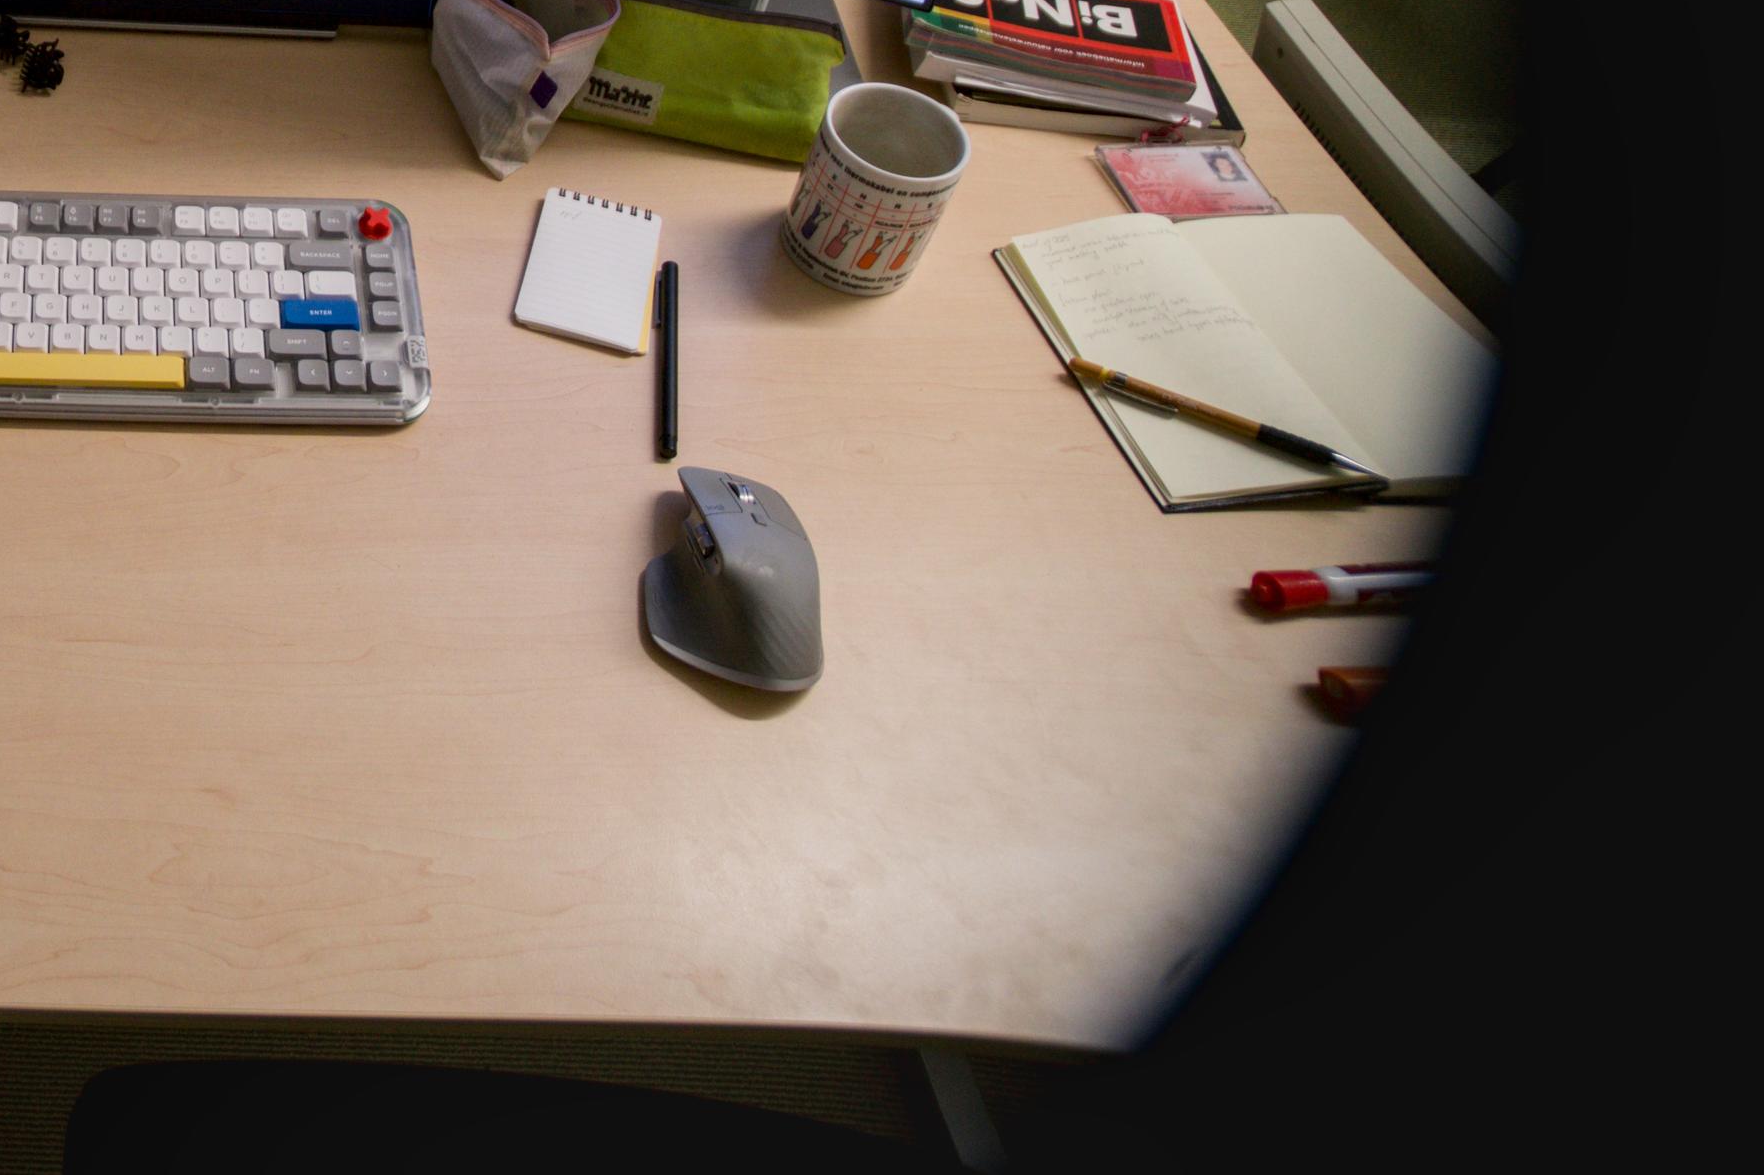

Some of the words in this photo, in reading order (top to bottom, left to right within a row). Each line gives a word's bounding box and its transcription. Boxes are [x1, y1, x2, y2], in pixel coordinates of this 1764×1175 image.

[1054, 47, 1074, 55] voor
[1076, 51, 1145, 68] Informatieboek
[844, 165, 895, 194] thermokabel
[300, 251, 340, 259] BACKSPACE
[202, 365, 216, 373] ALT
